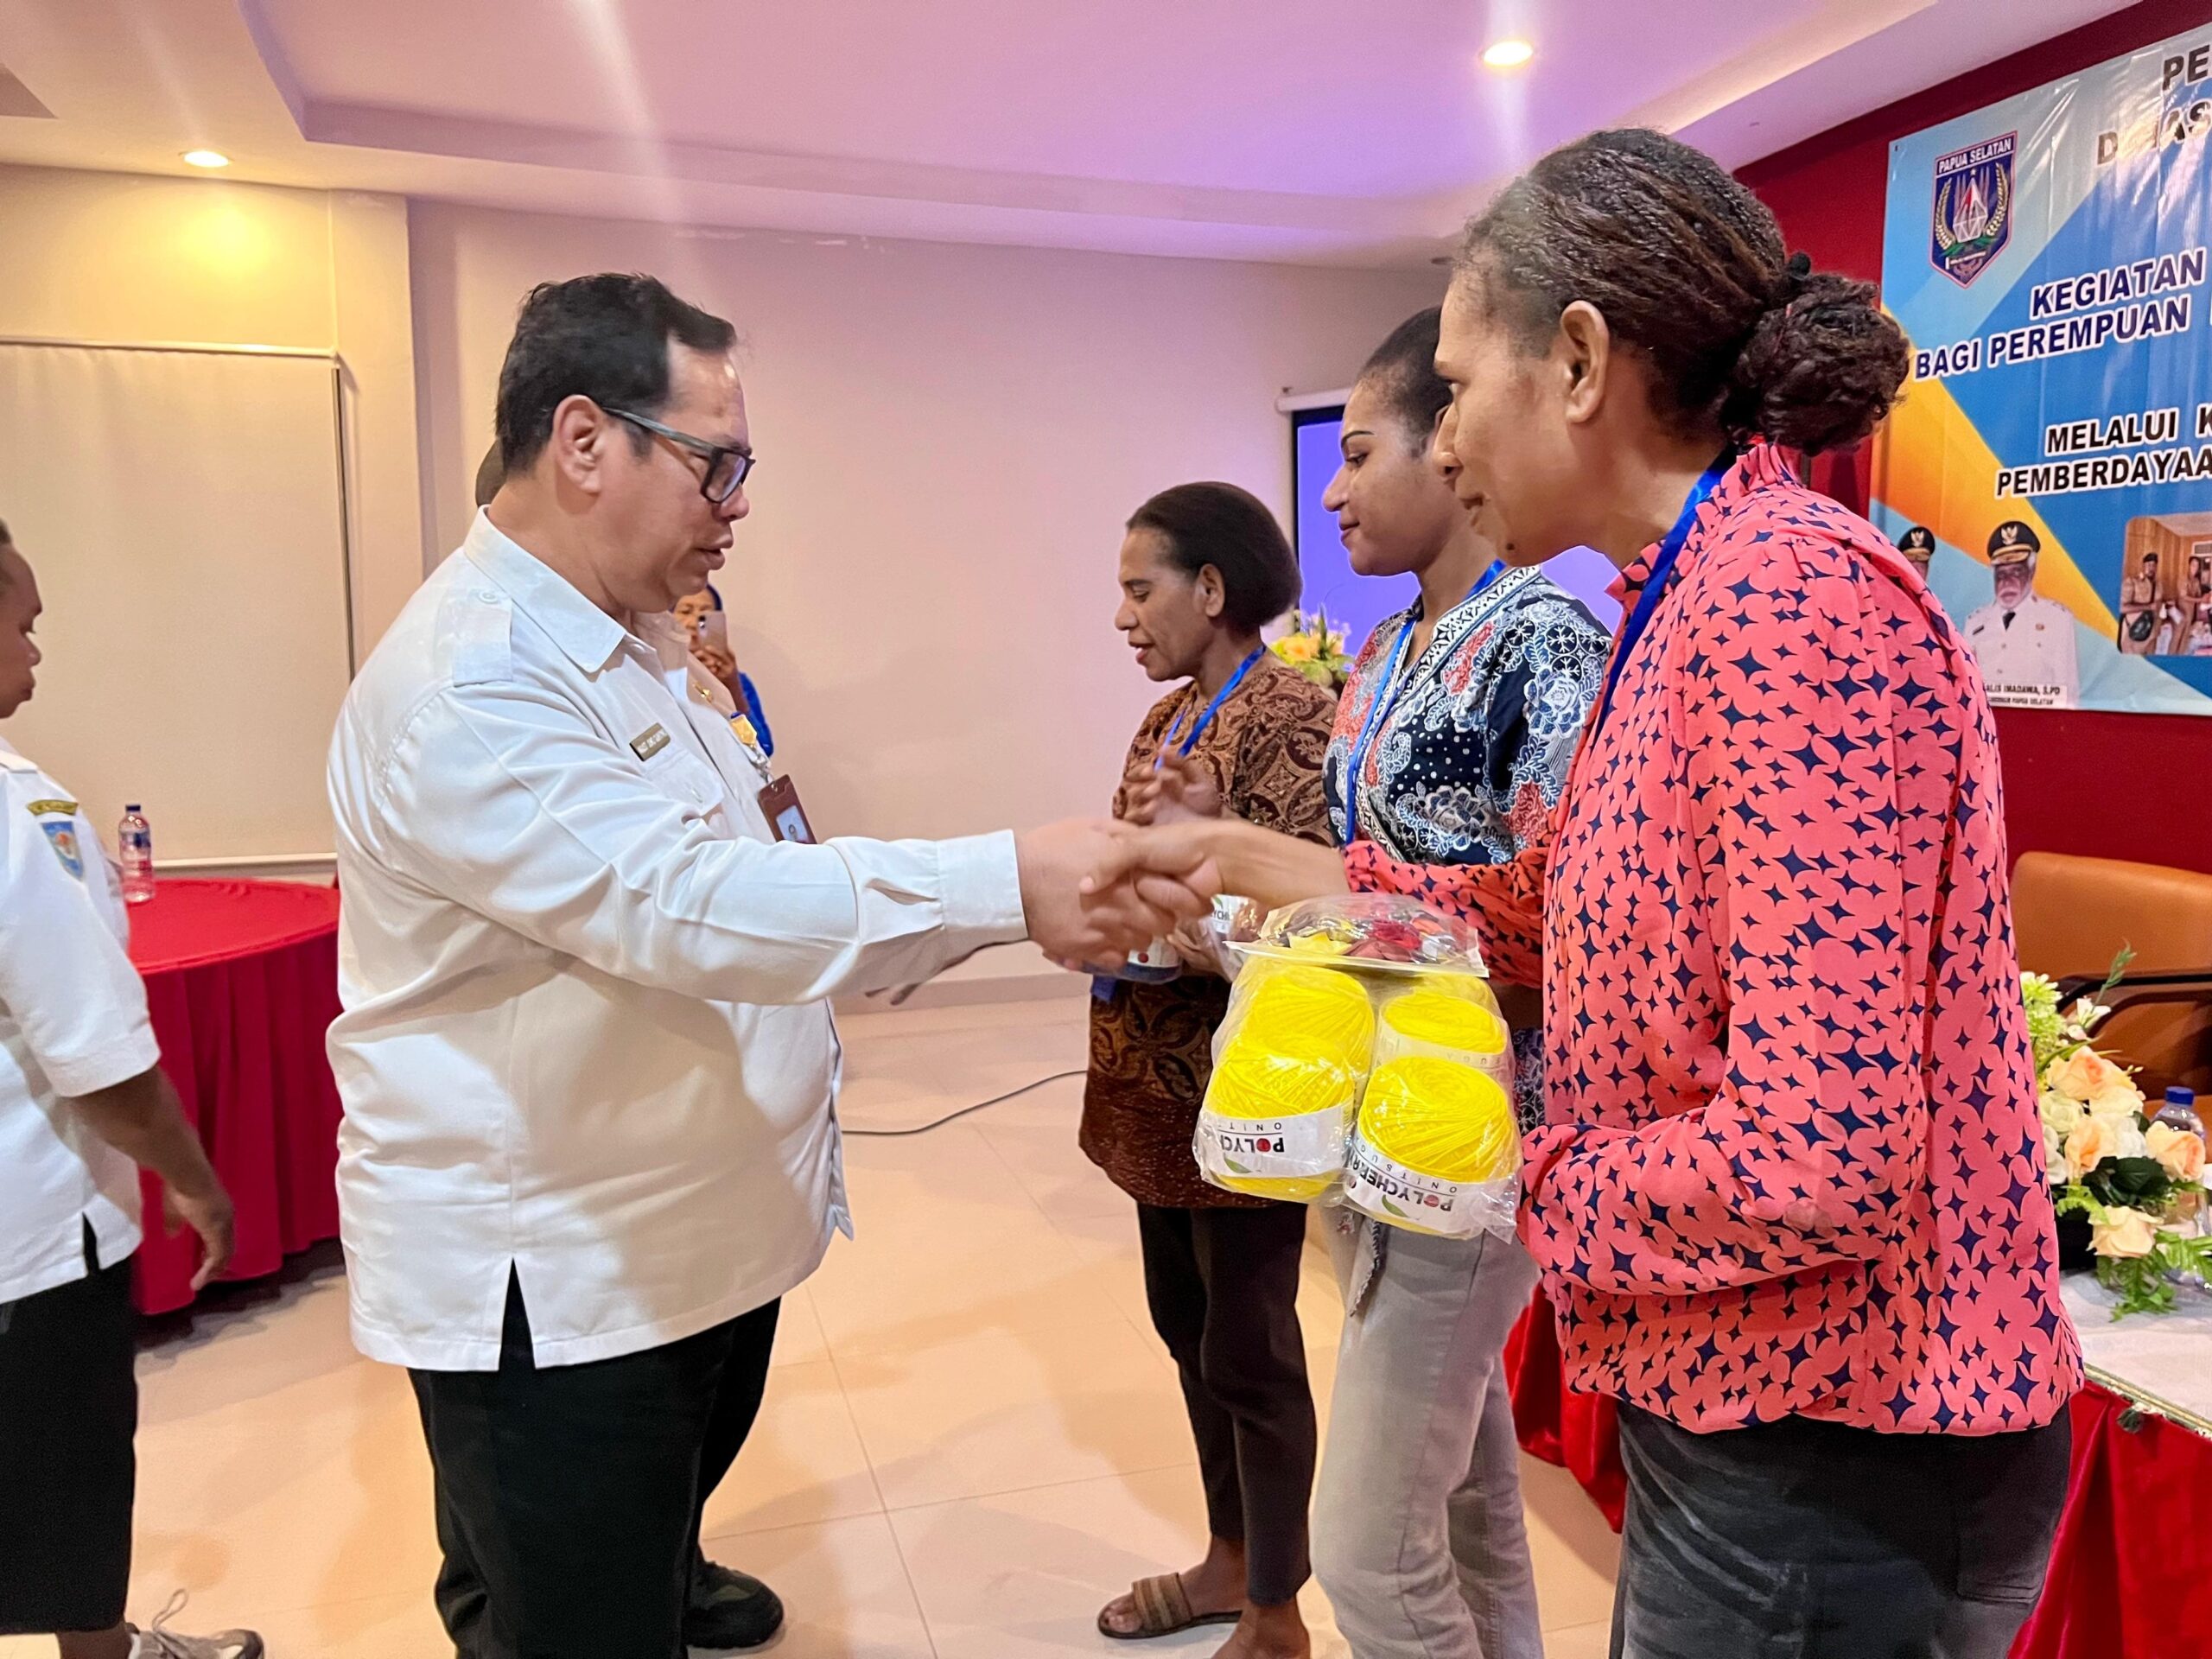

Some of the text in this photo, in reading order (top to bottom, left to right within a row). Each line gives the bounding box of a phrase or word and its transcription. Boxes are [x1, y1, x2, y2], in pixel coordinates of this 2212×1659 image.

[1938, 138, 2012, 174] PAPUA SELATAN
[2031, 250, 2205, 317] KEGIATAN
[1915, 296, 2190, 378] BAGI PEREMPUAN
[2047, 410, 2177, 454] MELALUI
[1997, 448, 2212, 497] PEMBERDAYAA
